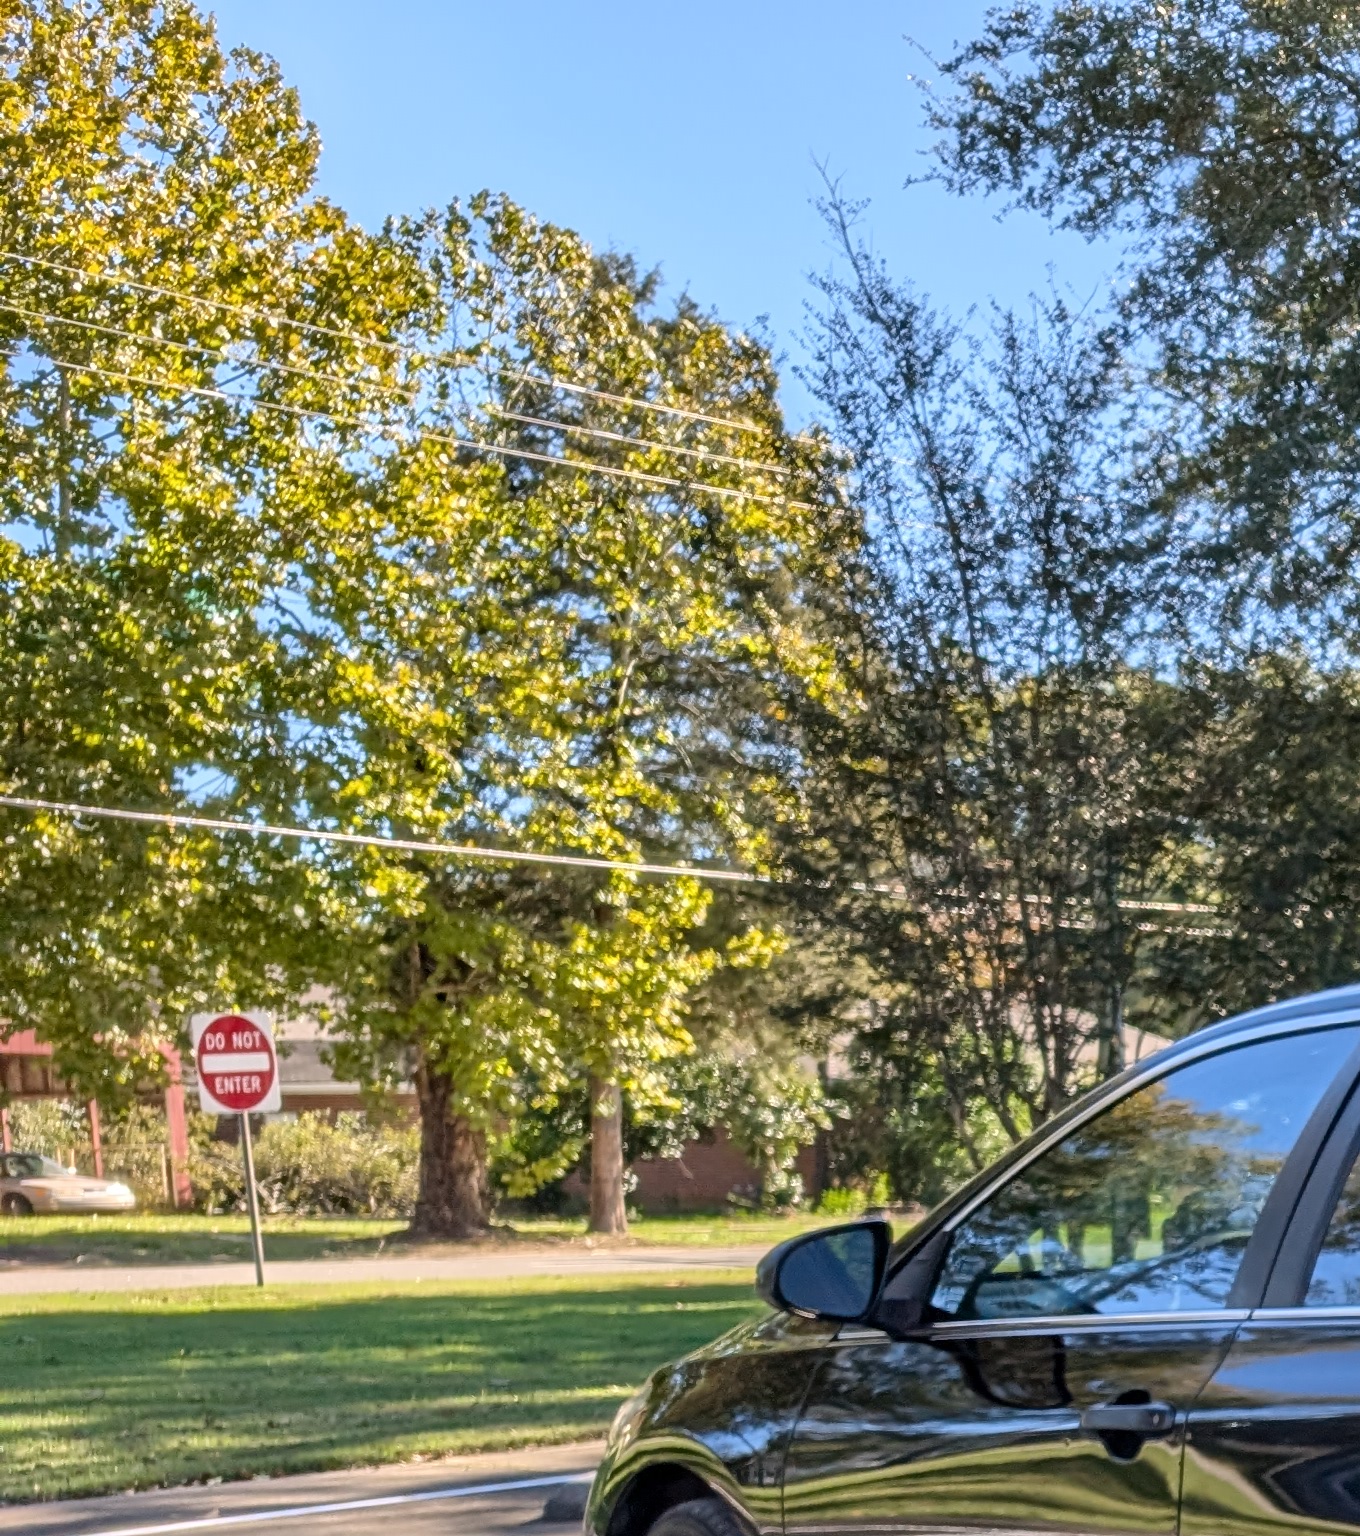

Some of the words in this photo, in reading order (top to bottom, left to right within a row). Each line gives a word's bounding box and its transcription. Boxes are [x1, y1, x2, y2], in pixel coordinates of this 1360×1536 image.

[205, 1032, 225, 1051] DO
[232, 1030, 261, 1050] NOT
[214, 1075, 261, 1095] ENTER
